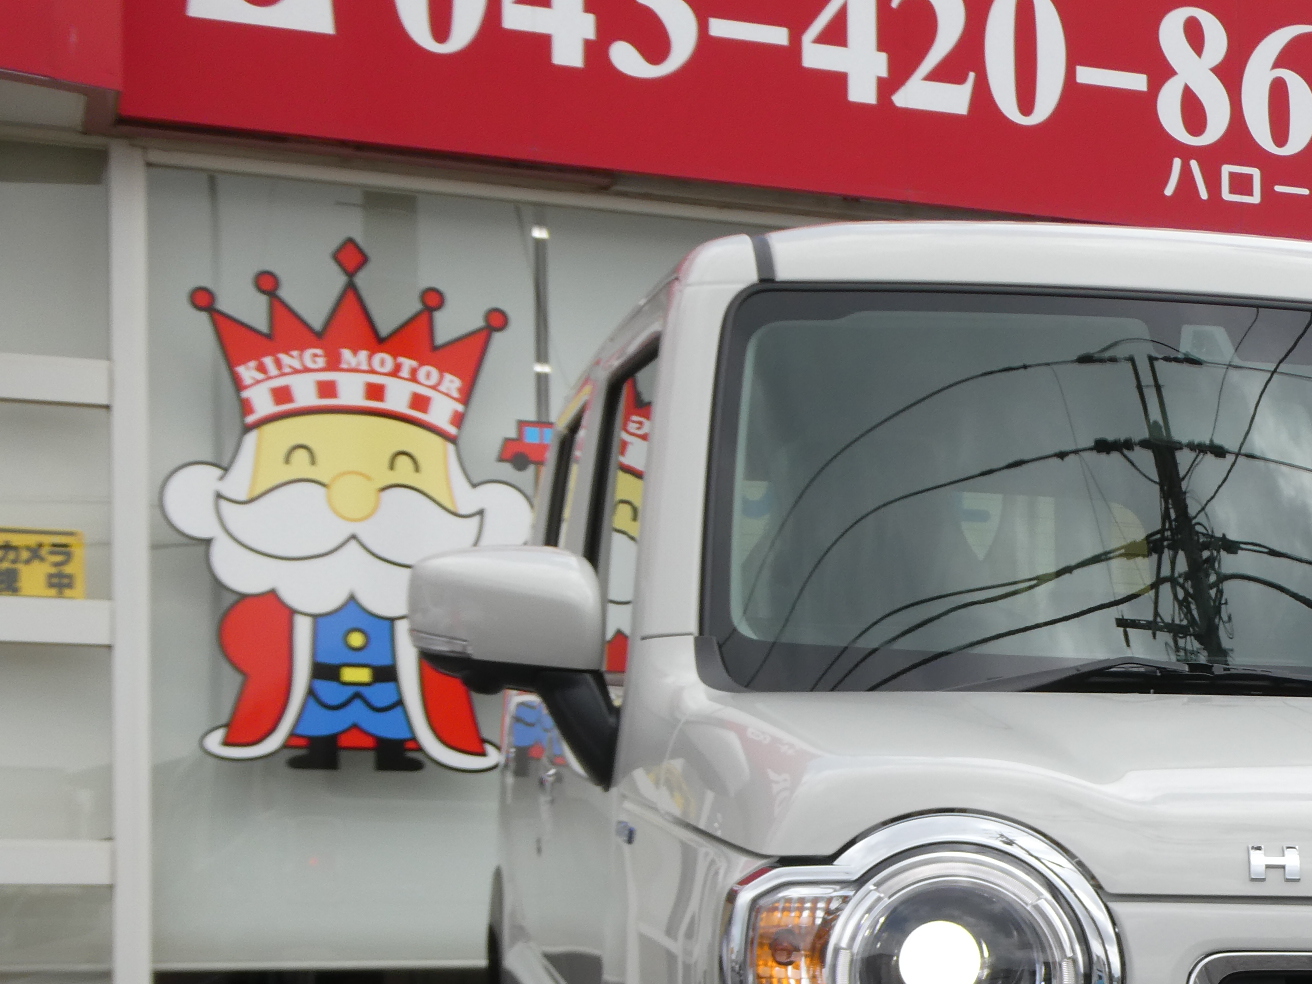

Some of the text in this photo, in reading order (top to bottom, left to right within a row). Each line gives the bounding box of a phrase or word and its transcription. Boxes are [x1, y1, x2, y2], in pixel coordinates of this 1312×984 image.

[1163, 157, 1310, 204] ハロー
[235, 348, 464, 398] KING MOTOR
